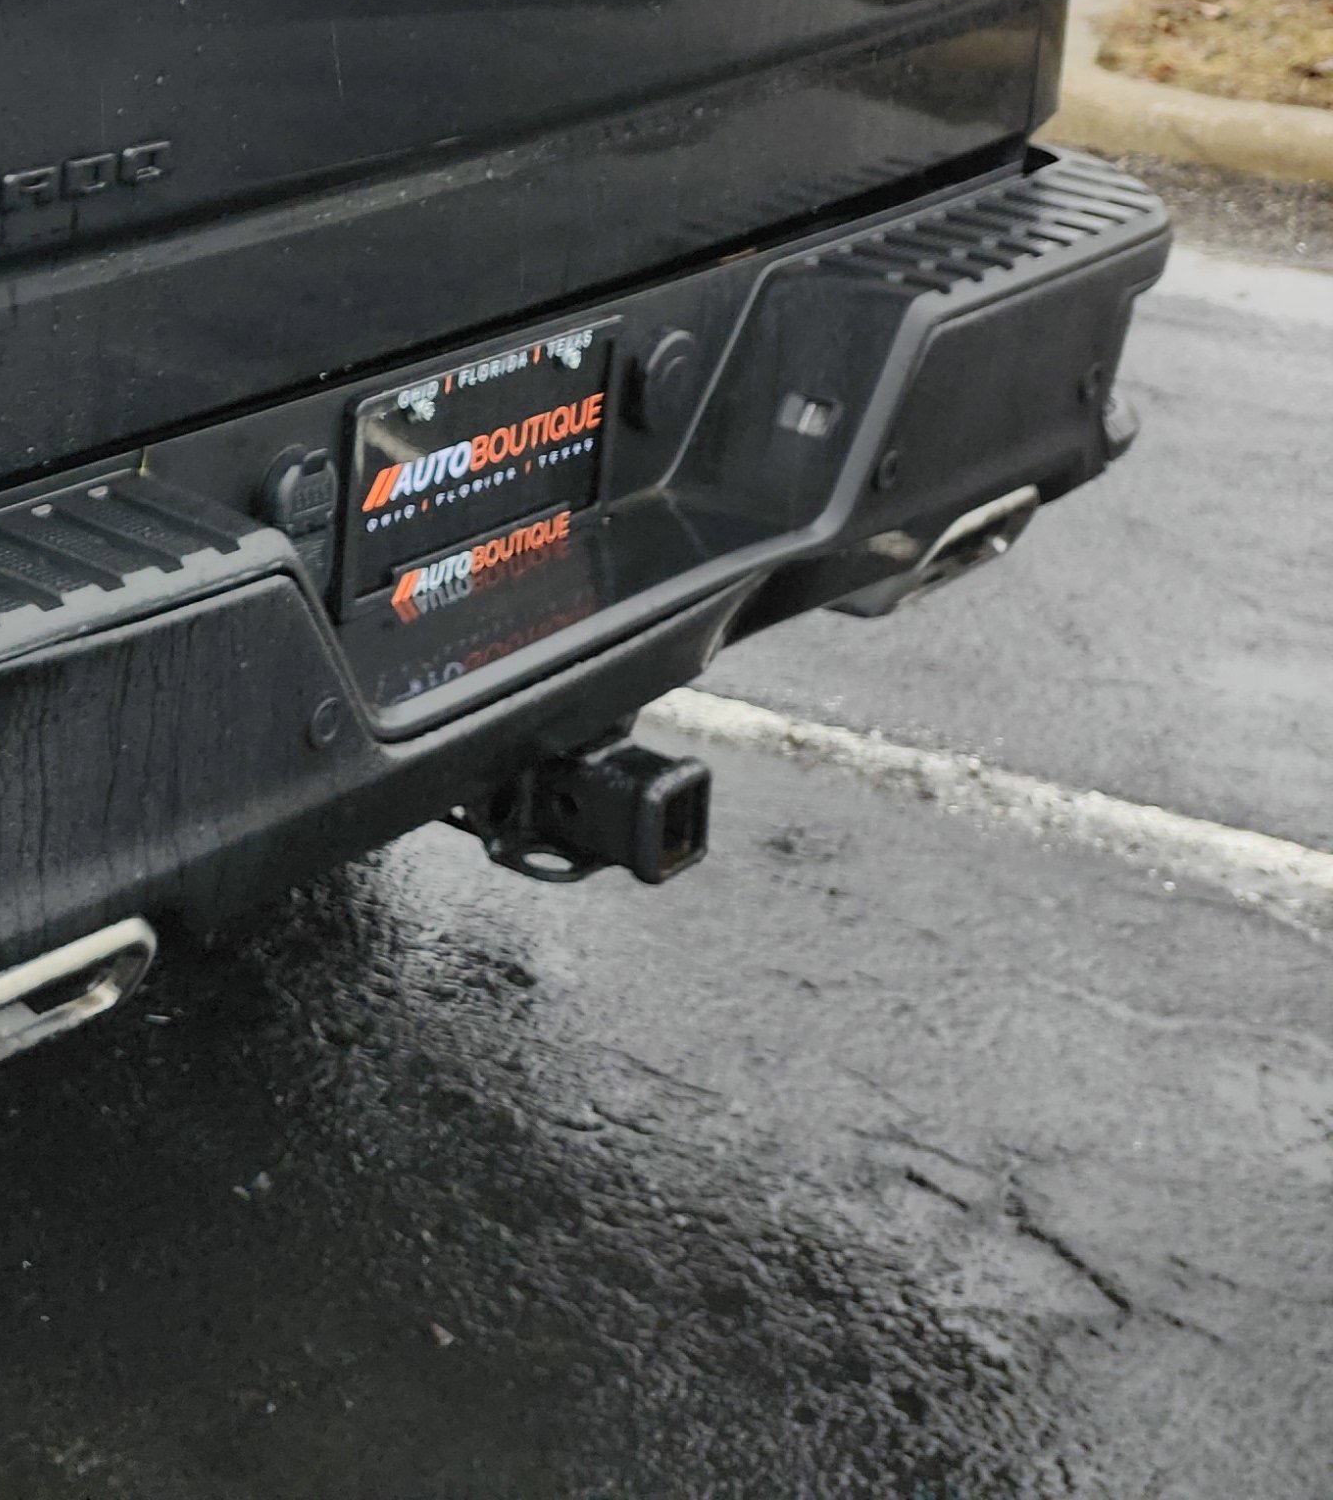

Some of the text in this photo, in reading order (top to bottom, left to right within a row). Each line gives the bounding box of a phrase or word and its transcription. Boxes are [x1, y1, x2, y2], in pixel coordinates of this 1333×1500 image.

[456, 350, 529, 389] FLORIDA
[388, 392, 605, 502] AUTOBOUTIQUE
[410, 510, 571, 598] AUTOBOUTIQUE
